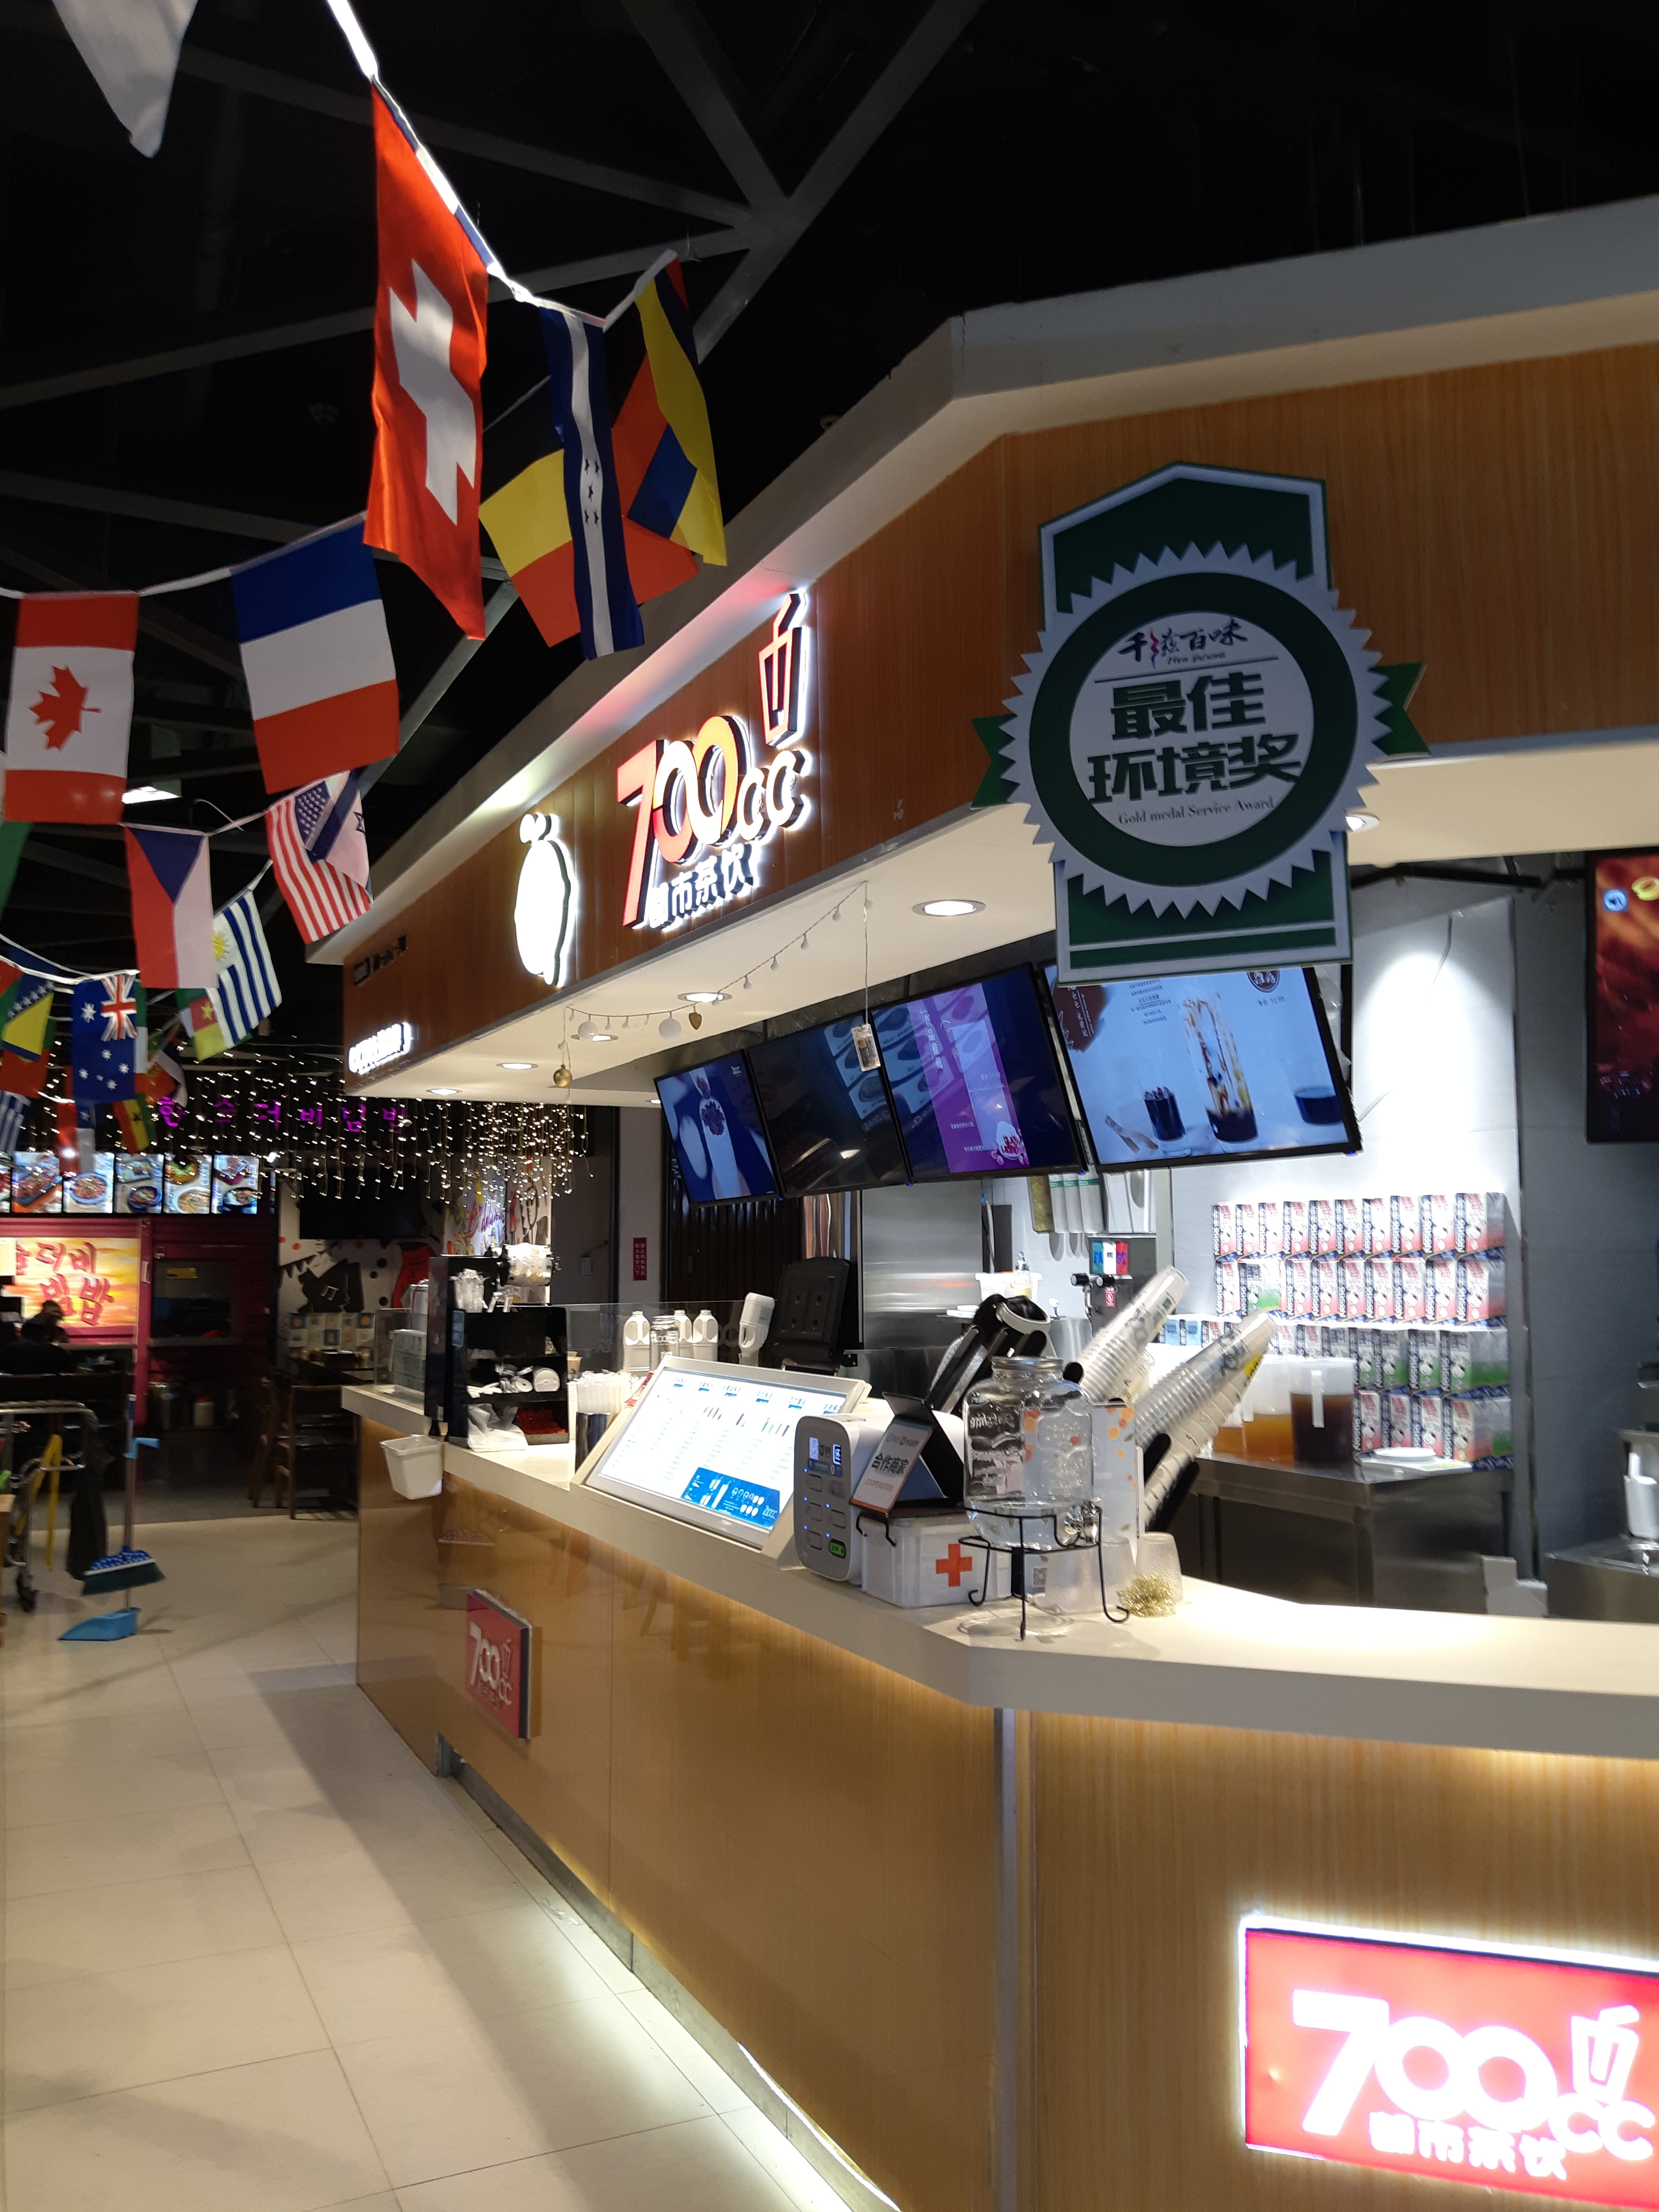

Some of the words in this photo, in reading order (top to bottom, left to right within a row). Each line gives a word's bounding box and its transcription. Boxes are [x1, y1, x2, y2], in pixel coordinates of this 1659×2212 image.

[1111, 672, 1266, 741] 最佳
[1087, 733, 1301, 805] 环境奖
[1118, 809, 1146, 825] Gold
[1150, 806, 1185, 822] medal
[1188, 801, 1231, 817] Service
[1237, 794, 1275, 812] Award
